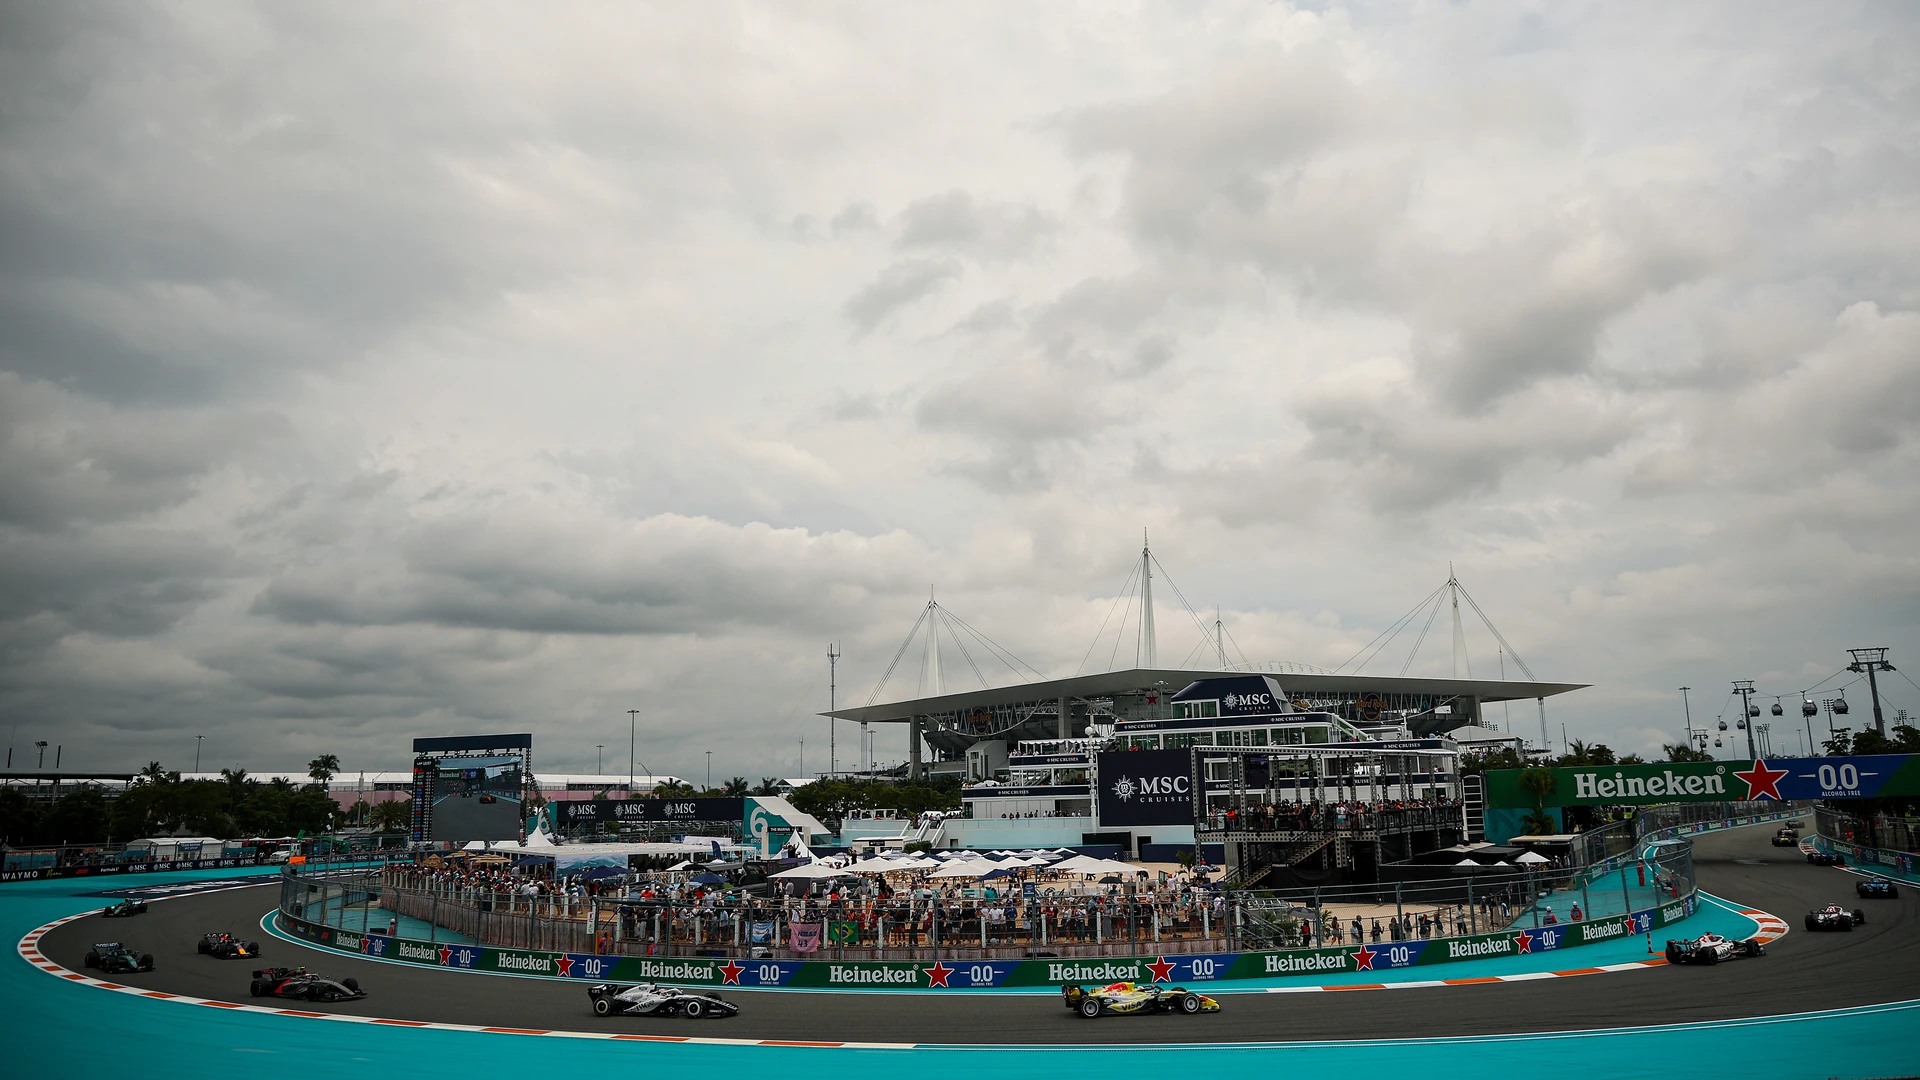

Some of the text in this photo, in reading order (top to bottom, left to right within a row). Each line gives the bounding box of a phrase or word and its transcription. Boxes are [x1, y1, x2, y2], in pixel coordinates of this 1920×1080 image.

[1239, 694, 1270, 705] MSC
[1356, 698, 1388, 709] Hard Rock
[1139, 776, 1189, 794] MSC
[1574, 764, 1858, 798] Heineken 0.0
[577, 805, 596, 815] MSC
[625, 804, 644, 814] MSC
[675, 803, 696, 813] MSC
[750, 806, 768, 838] 6
[2, 871, 38, 880] WAYMO
[1663, 904, 1683, 922] Heineken
[1582, 922, 1623, 940] Heineken
[336, 933, 360, 948] Heineken
[798, 939, 808, 947] 43
[1448, 930, 1555, 957] Heineken 0.0
[399, 942, 471, 964] Heineken 0.0
[1265, 946, 1408, 972] Heineken 0.0
[498, 952, 600, 974] Heineken 0.0
[640, 960, 780, 981] Heineken 0.0
[1048, 958, 1214, 980] Heineken 0.0
[830, 965, 993, 983] Heineken 0.0
[1121, 1001, 1142, 1011] VISA
